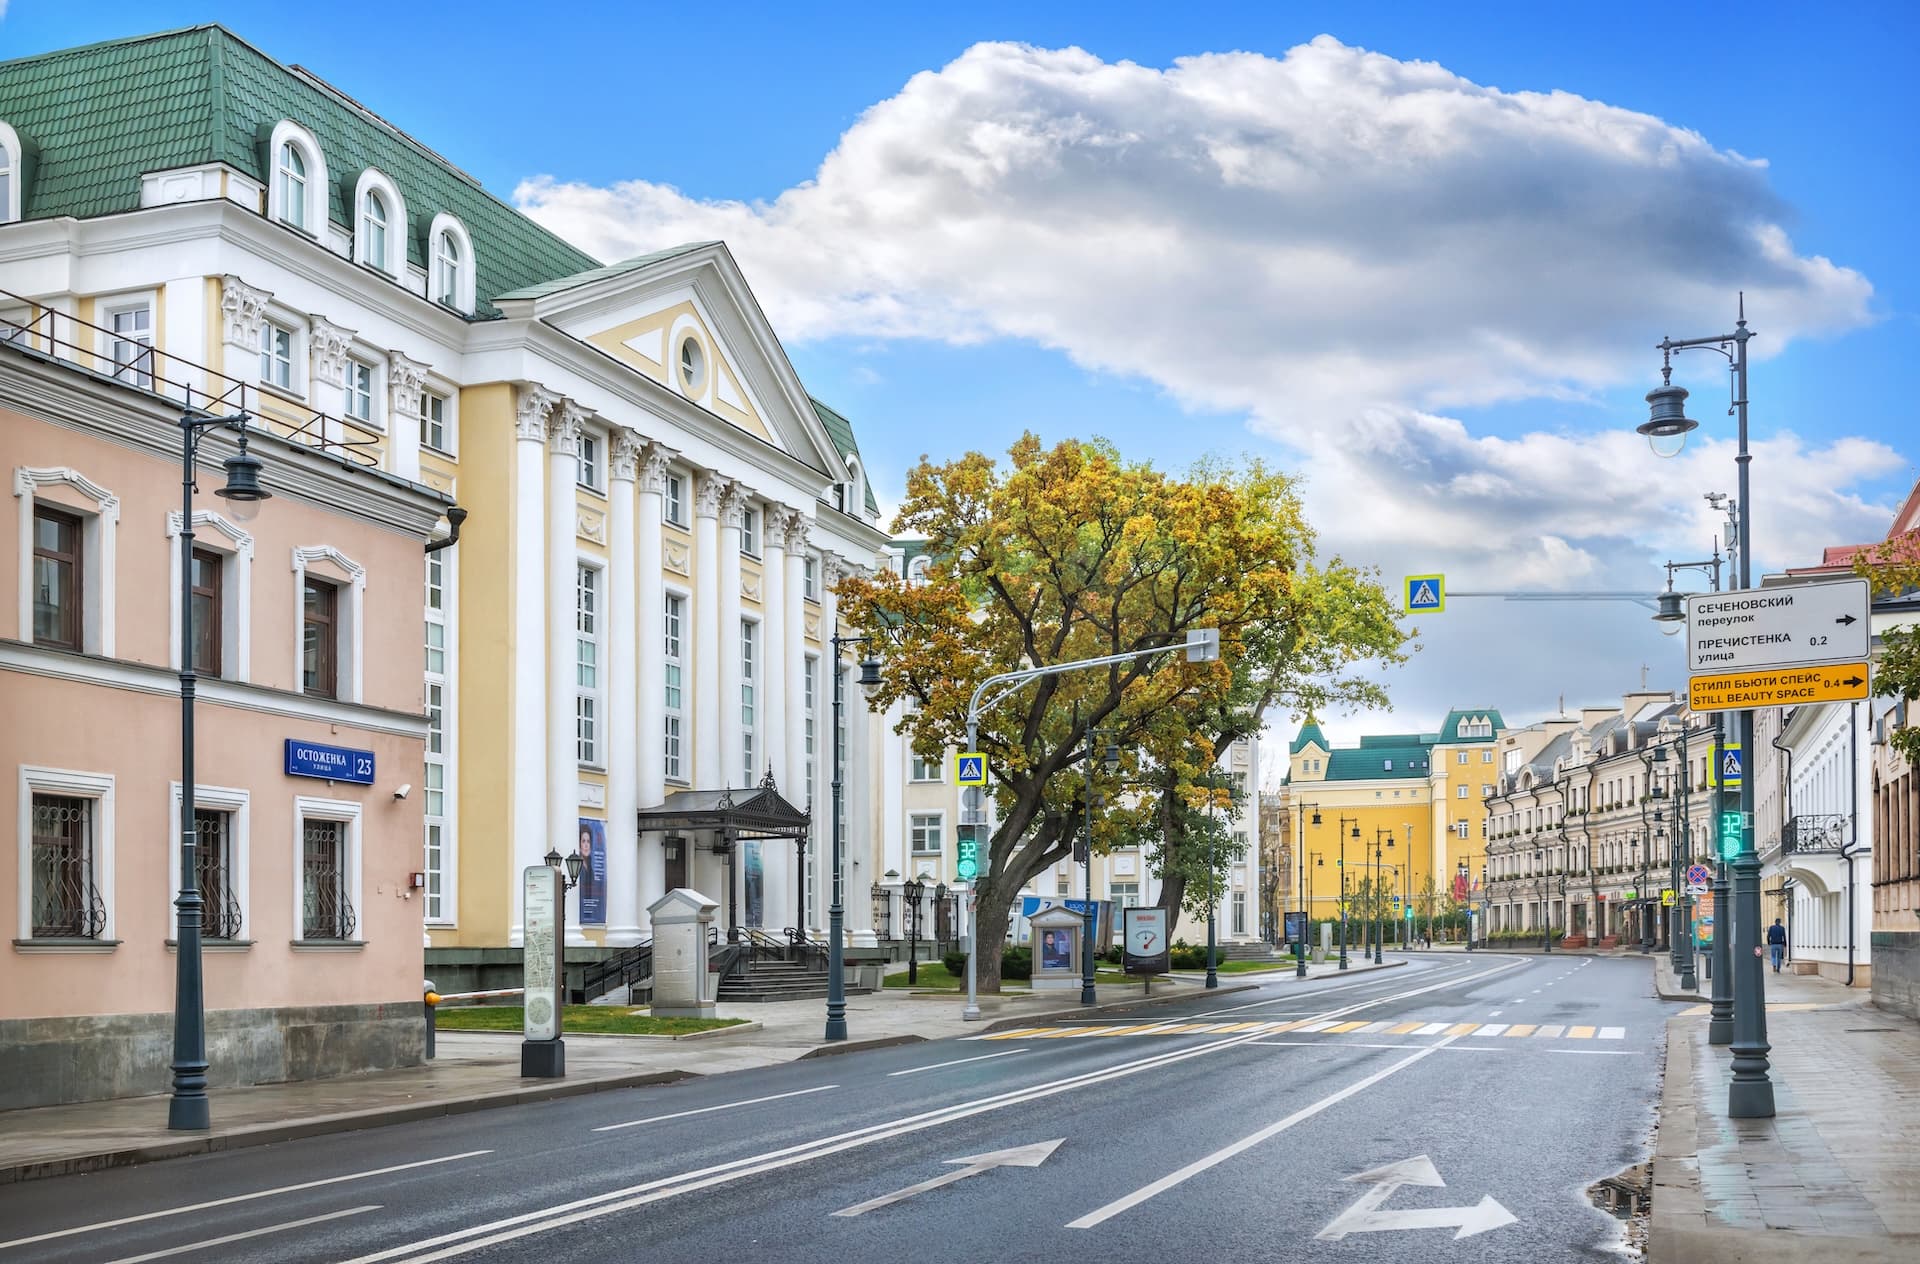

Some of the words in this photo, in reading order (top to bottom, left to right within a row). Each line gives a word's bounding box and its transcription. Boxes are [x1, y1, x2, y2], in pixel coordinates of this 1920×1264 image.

[1698, 595, 1793, 613] СЕЧЕНОВСКИЙ
[1698, 615, 1754, 627] переулок
[1698, 633, 1791, 649] ПРЕЧИСТЕНКА
[1810, 637, 1828, 646] 0.2
[1698, 652, 1734, 663] улица
[1694, 681, 1731, 691] СТИЛЛ
[1734, 677, 1777, 689] БЬЮТИ
[1780, 673, 1822, 686] СПЕЙС
[1824, 680, 1840, 688] 0.4
[1694, 696, 1723, 705] STILL
[1727, 690, 1774, 703] BEAUTY
[1776, 687, 1816, 699] SPACE
[297, 749, 346, 766] ОСТОЖЕНКА
[357, 758, 372, 775] 23
[1723, 815, 1740, 834] 32
[961, 843, 976, 859] 32
